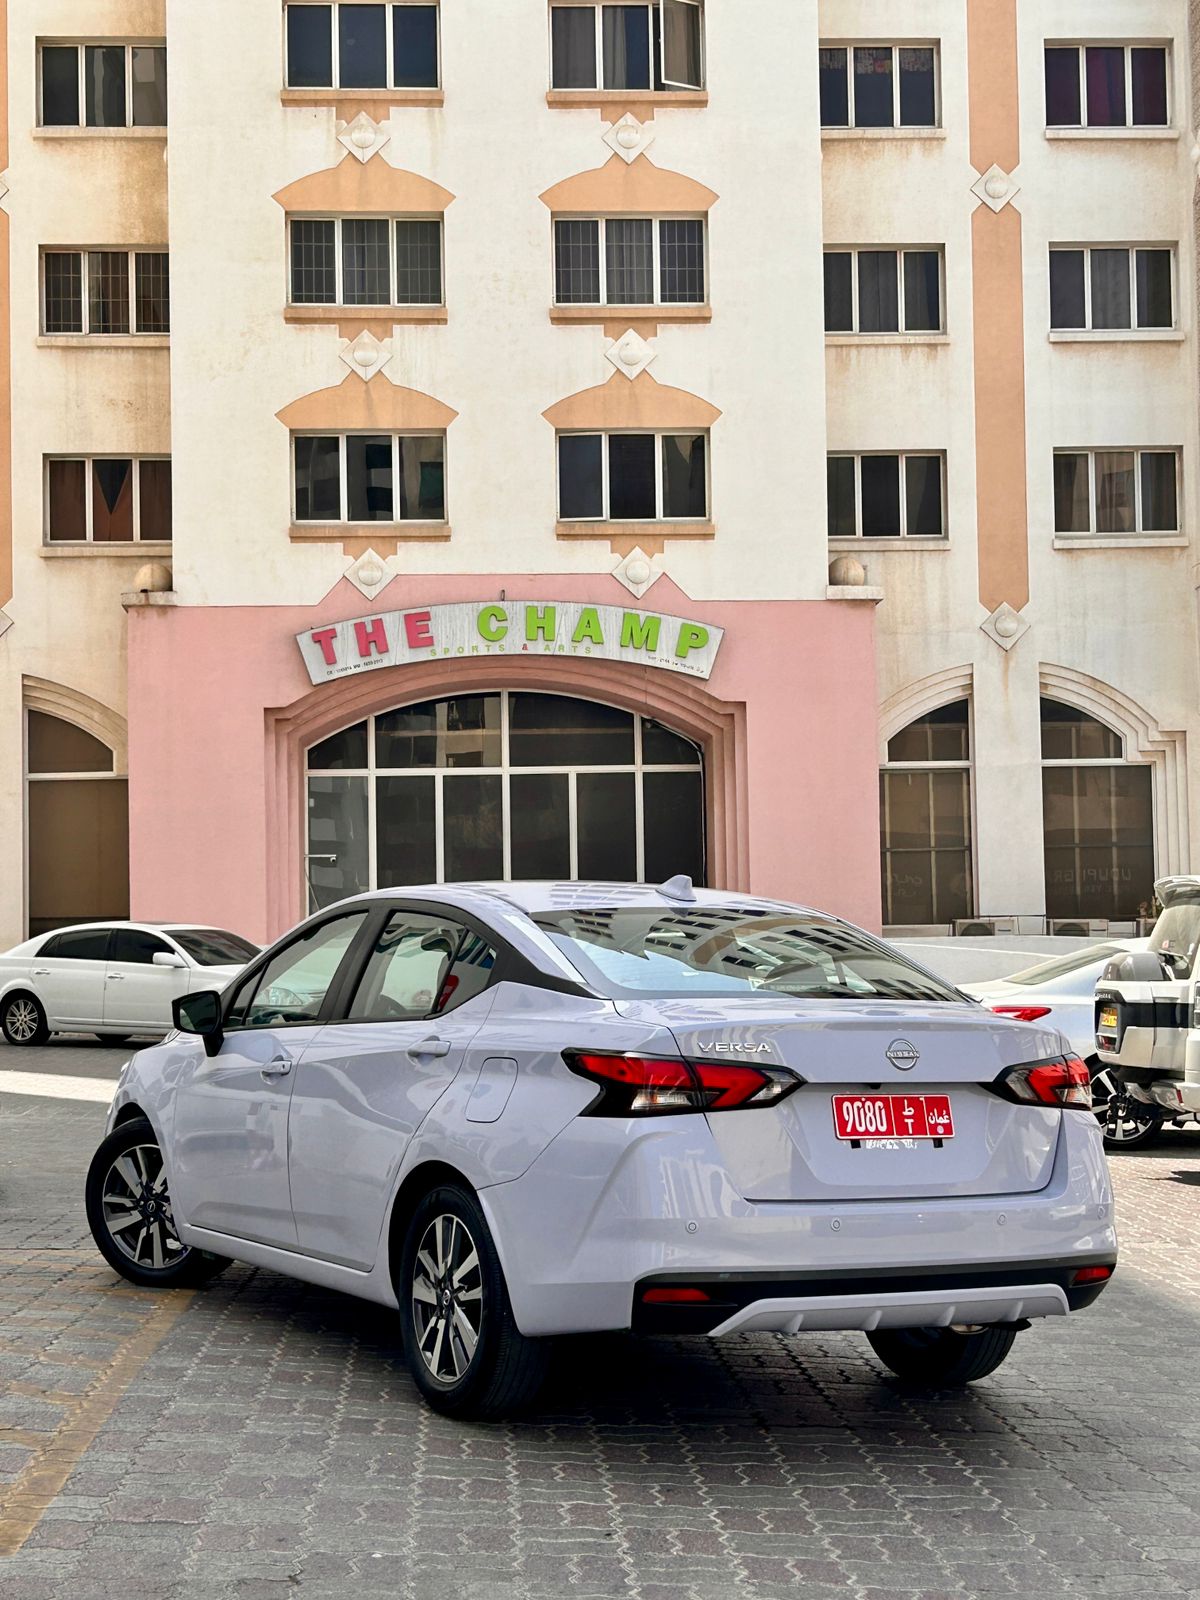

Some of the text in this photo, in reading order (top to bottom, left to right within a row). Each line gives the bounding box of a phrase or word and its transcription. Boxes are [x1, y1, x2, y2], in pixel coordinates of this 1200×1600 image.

[311, 605, 710, 666] THE CHAMP
[430, 643, 592, 657] SPORTS & ARTS
[697, 1042, 773, 1053] VERSA
[886, 1050, 920, 1058] NISSAN
[902, 1099, 915, 1116] ط
[842, 1101, 887, 1133] 9080
[904, 1118, 914, 1134] T
